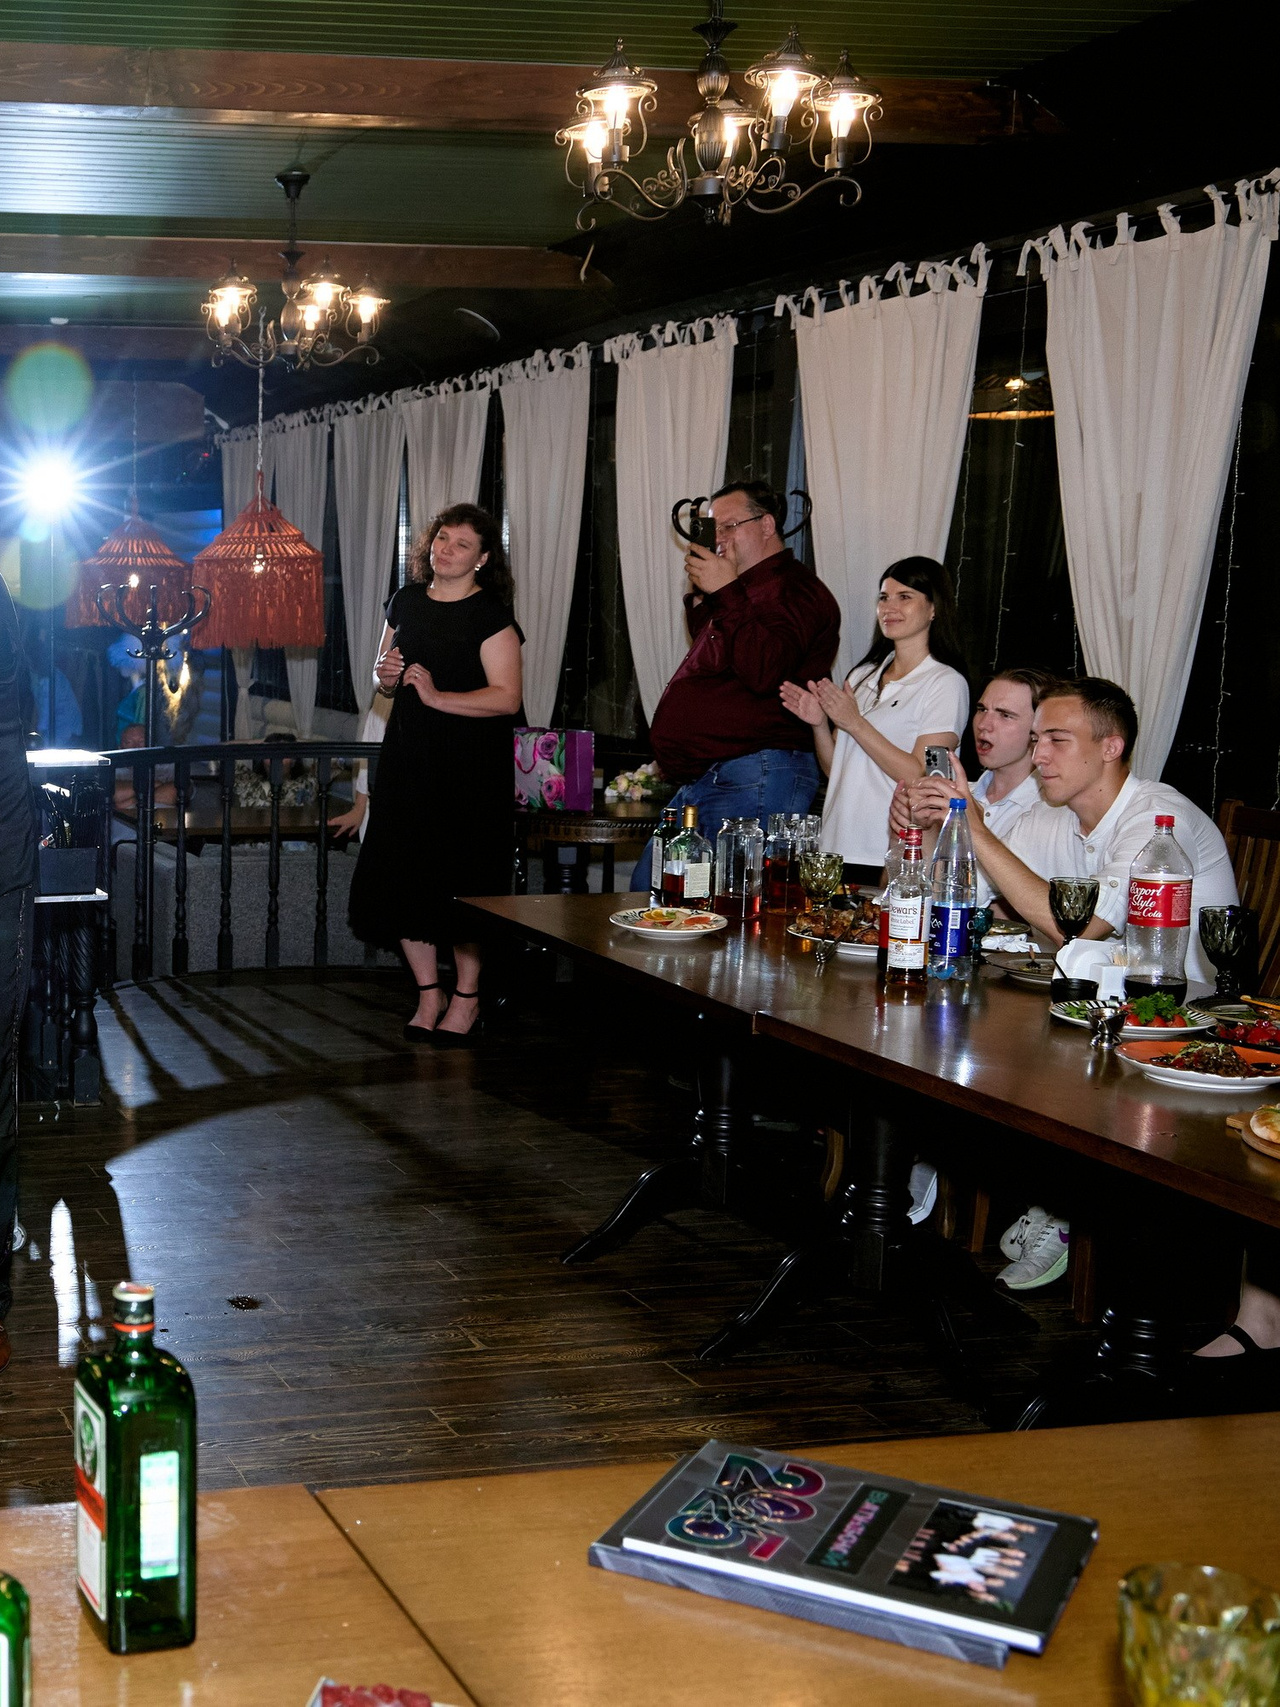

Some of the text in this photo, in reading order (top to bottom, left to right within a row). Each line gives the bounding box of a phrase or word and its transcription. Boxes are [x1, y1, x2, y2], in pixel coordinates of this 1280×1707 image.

[1130, 882, 1165, 899] Export
[1131, 894, 1157, 910] Style
[1142, 907, 1163, 918] Cola
